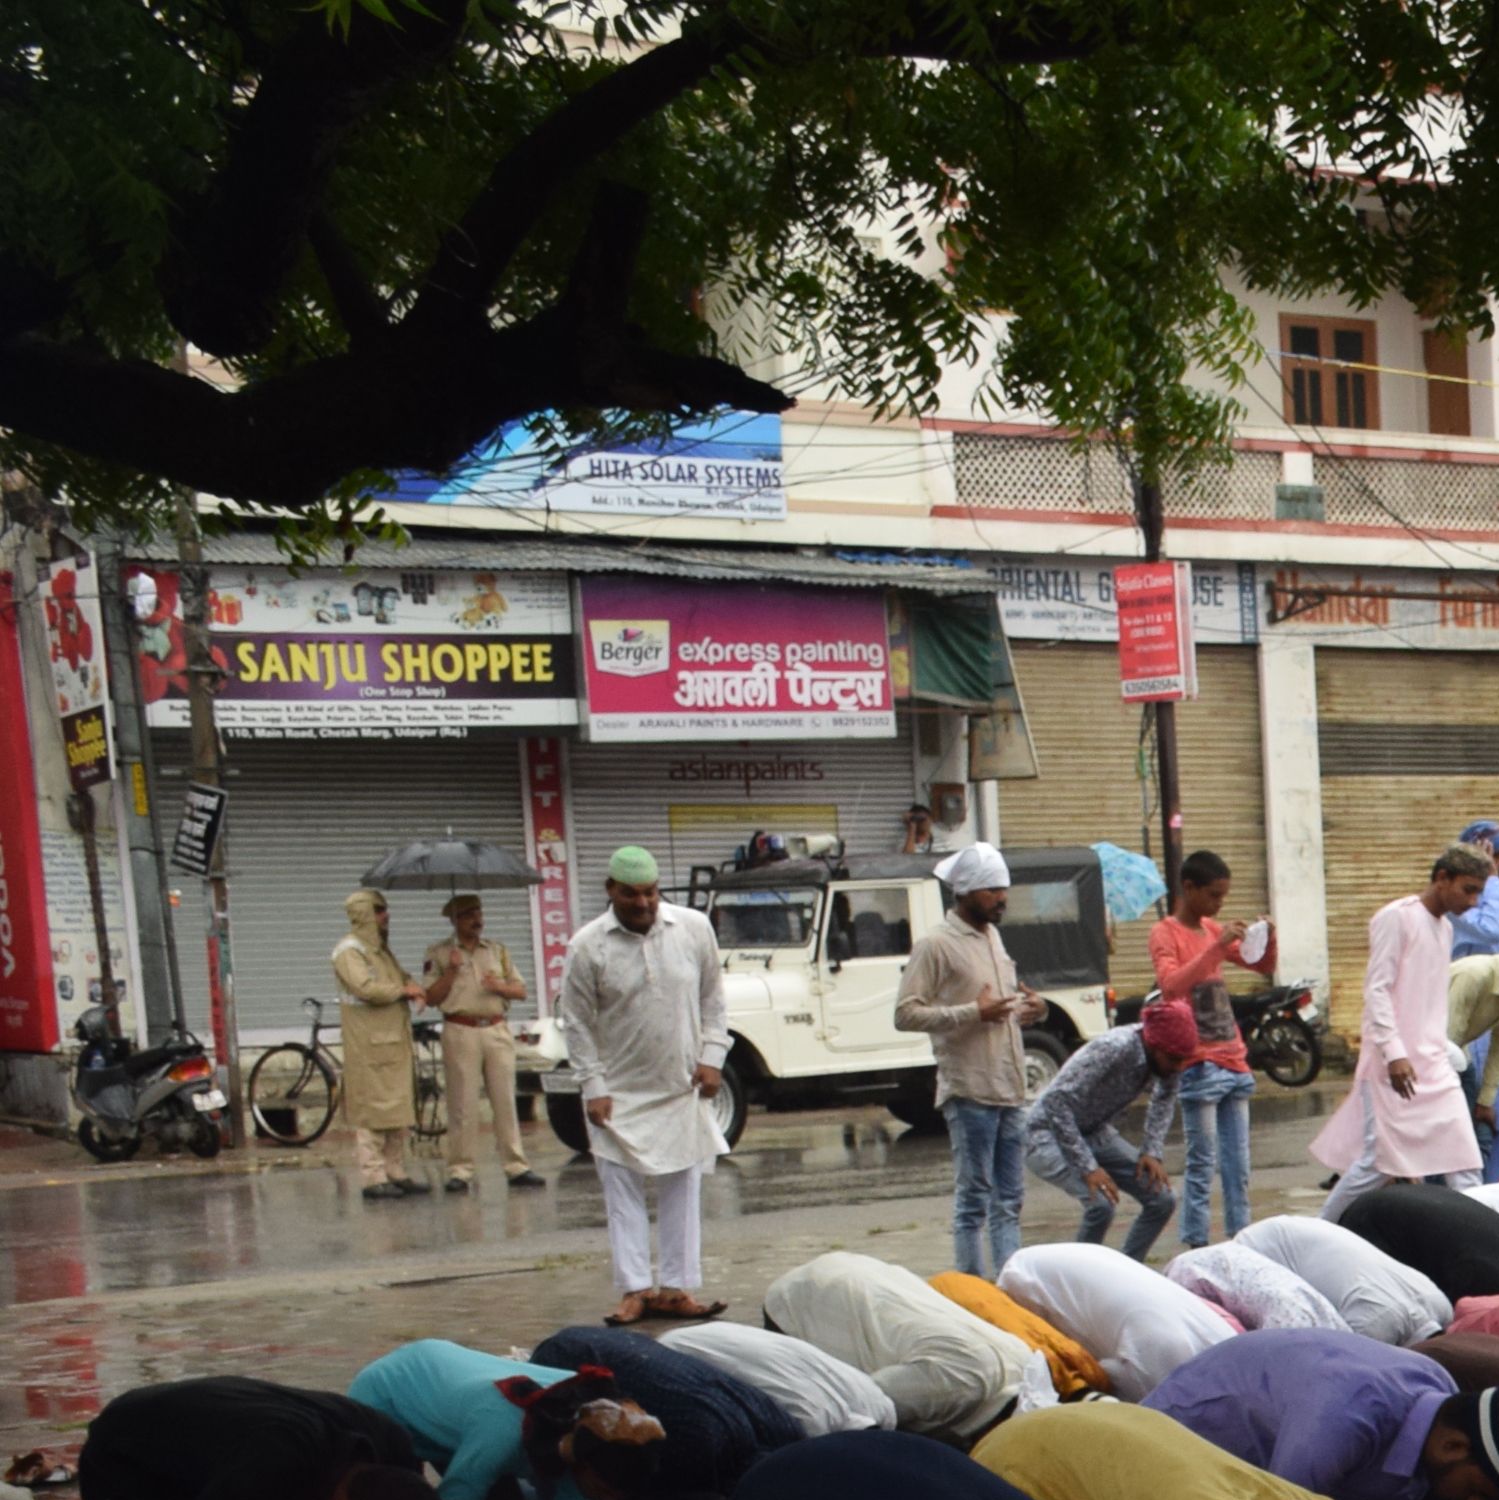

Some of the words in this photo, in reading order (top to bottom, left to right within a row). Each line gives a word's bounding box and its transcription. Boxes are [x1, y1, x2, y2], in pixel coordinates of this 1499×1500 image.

[640, 462, 698, 483] SOLAR
[704, 465, 782, 488] SYSTEMS
[600, 641, 664, 665] Berger
[677, 637, 781, 664] express
[785, 640, 885, 668] painting
[236, 642, 367, 691] SANJU
[381, 642, 555, 683] SHOPPEE
[359, 686, 386, 698] (One
[389, 687, 414, 699] Stop
[415, 686, 446, 699] Shop)
[673, 661, 781, 708] अरावली
[227, 729, 252, 740] 110,
[255, 729, 283, 738] Main
[285, 729, 317, 740] Road,
[319, 728, 358, 739] Chetak
[361, 727, 393, 740] Marg,
[394, 727, 437, 739] Udaipur
[439, 727, 468, 738] (Raj.)
[638, 719, 686, 729] ARAVALI
[688, 719, 729, 729] PAINTS
[731, 719, 739, 729] &
[741, 718, 804, 729] HARDWARE
